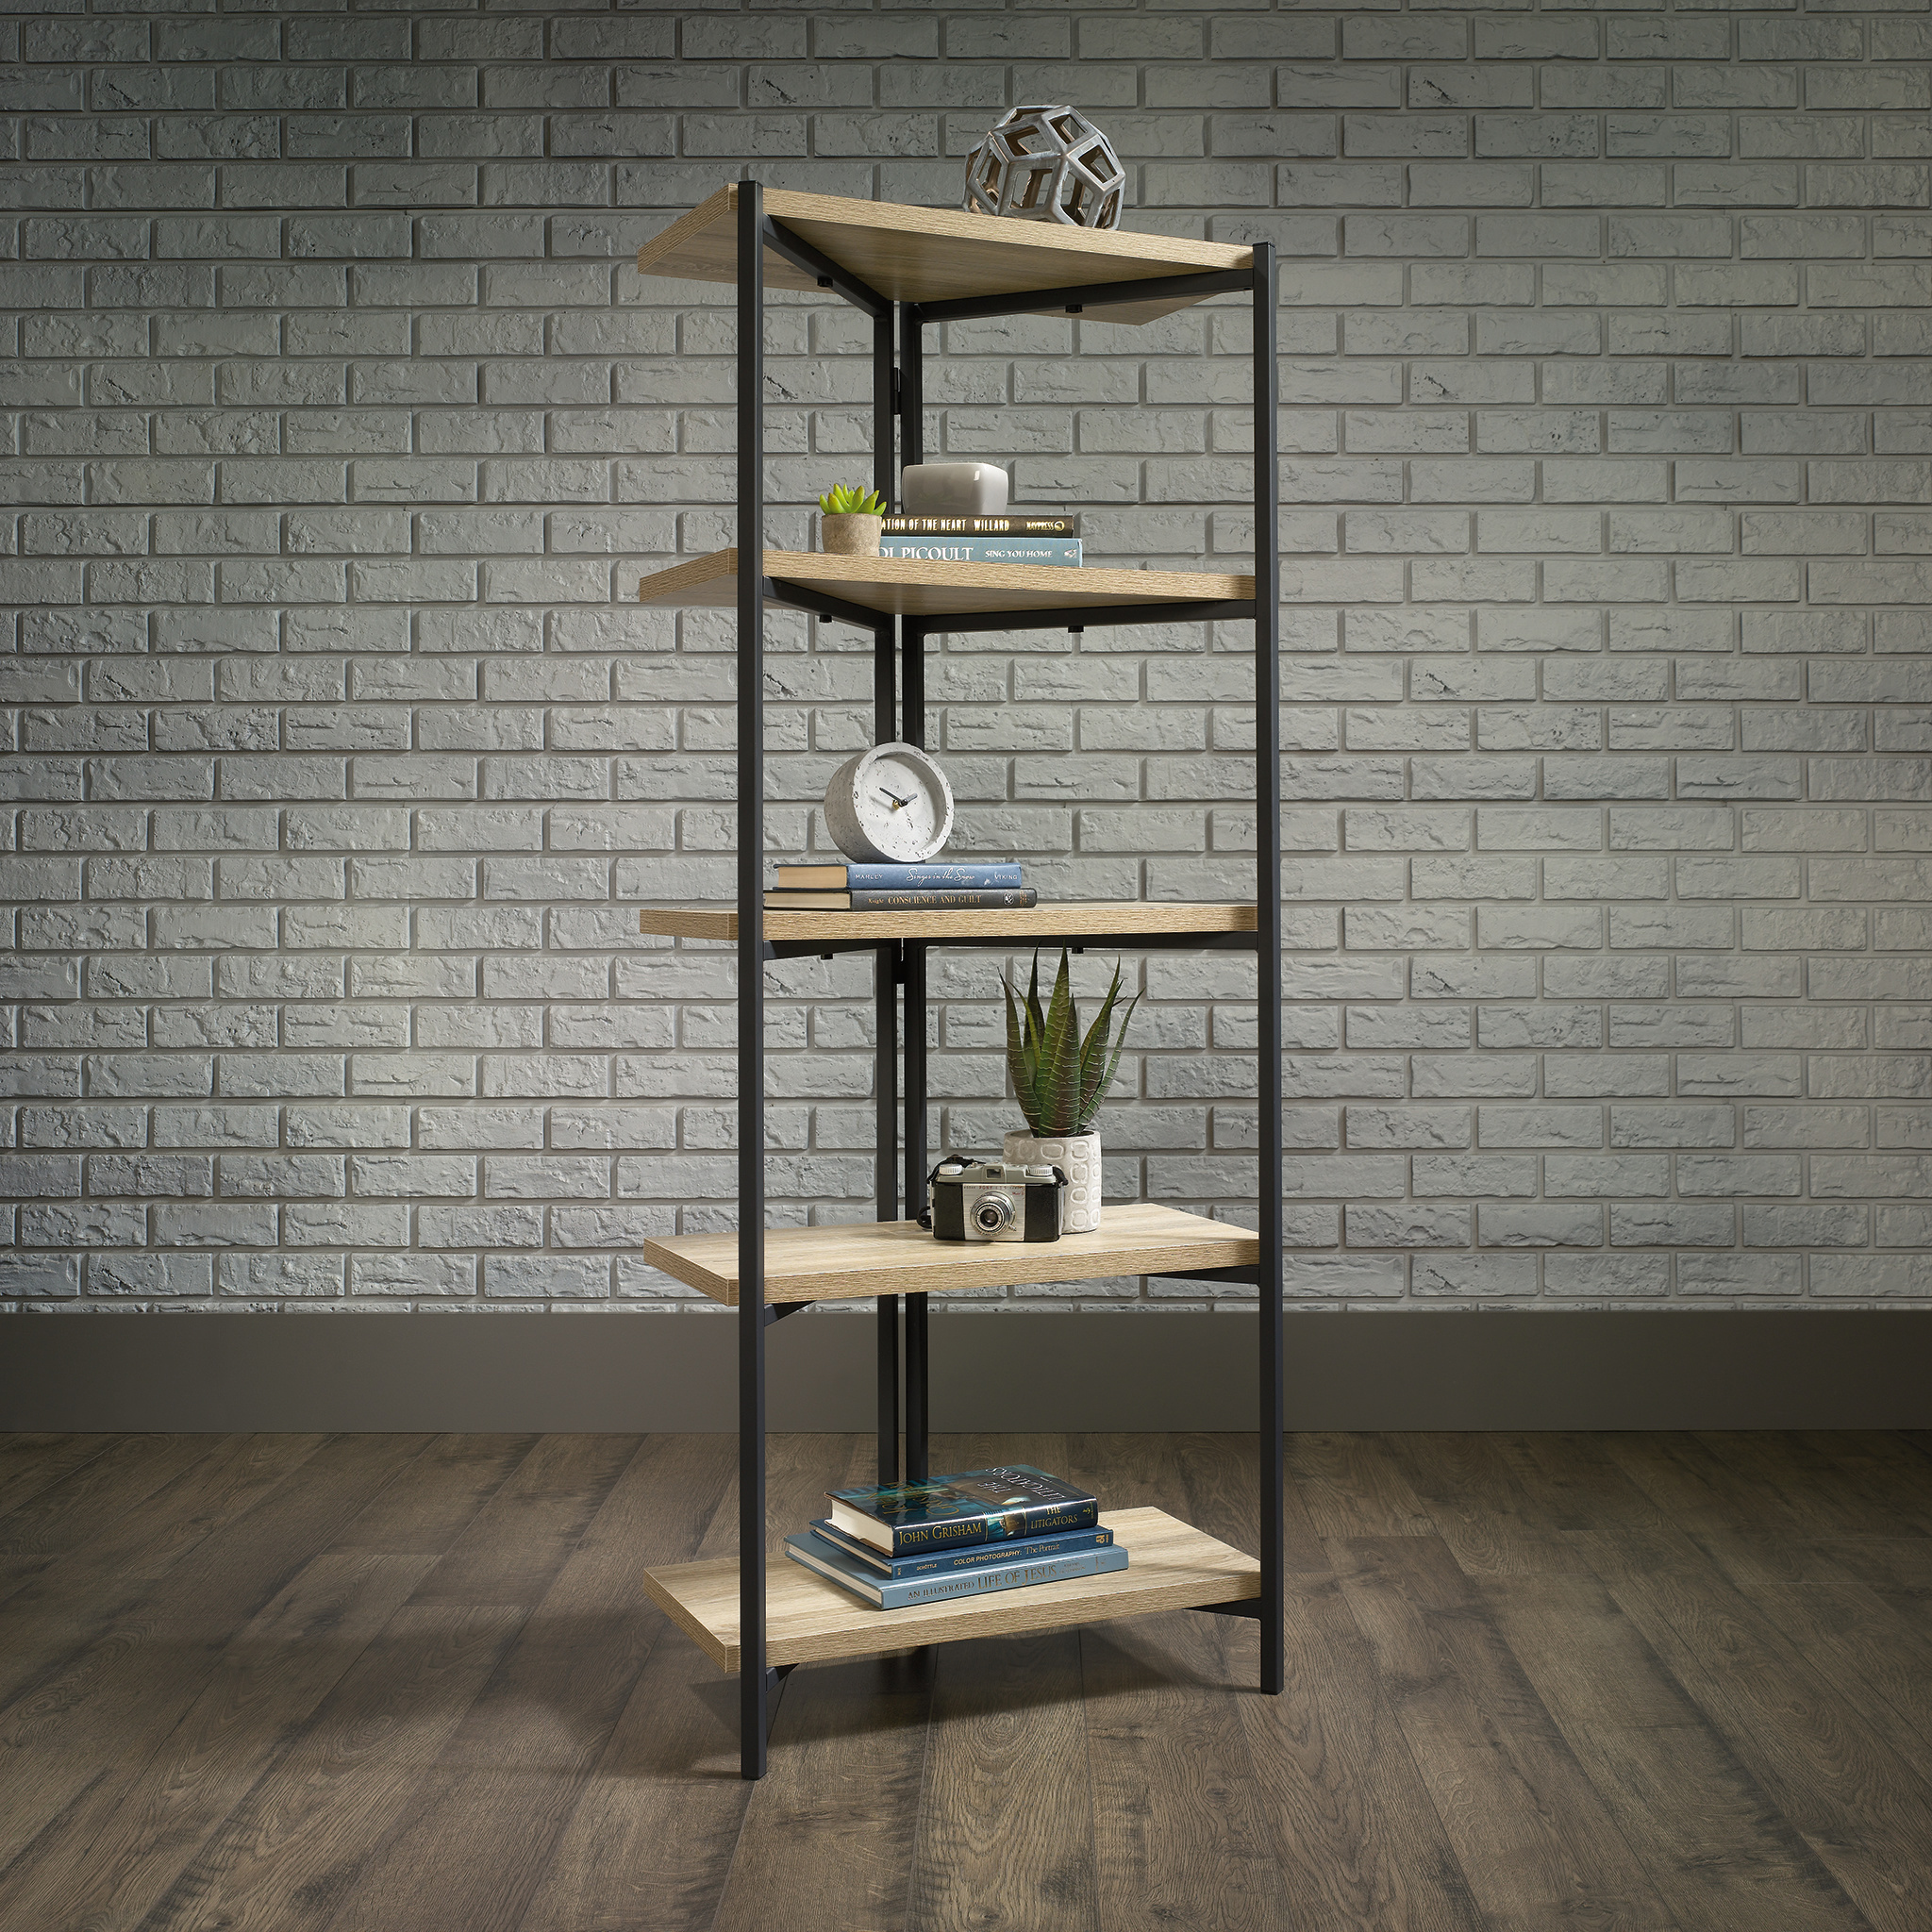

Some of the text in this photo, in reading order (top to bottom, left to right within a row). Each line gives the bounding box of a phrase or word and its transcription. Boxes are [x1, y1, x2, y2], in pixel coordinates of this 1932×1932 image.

[908, 519, 919, 531] OF
[922, 519, 938, 531] THE
[941, 519, 967, 531] HEART
[974, 519, 1010, 531] WILLARD
[901, 547, 974, 561] PICOULT
[932, 872, 941, 880] in
[942, 867, 954, 880] the
[954, 867, 975, 882] Snow
[993, 871, 1018, 880] VIKING
[888, 895, 938, 905] CONSCIENCE
[940, 895, 957, 904] AND
[958, 894, 982, 904] GUILT
[1045, 1506, 1061, 1516] THE
[1030, 1513, 1078, 1530] LITIGATORS
[899, 1522, 982, 1545] JOHN GRISHAM
[954, 1556, 975, 1566] COLOR
[975, 1550, 1023, 1562] PHOTOGRAPHY:
[1024, 1545, 1039, 1555] The
[1039, 1542, 1060, 1553] Portrait
[908, 1591, 921, 1601] AN
[923, 1581, 974, 1597] ILLUSTRATED
[977, 1574, 1003, 1591] LIFE
[1005, 1571, 1020, 1585] OF
[1022, 1565, 1057, 1586] JESUS
